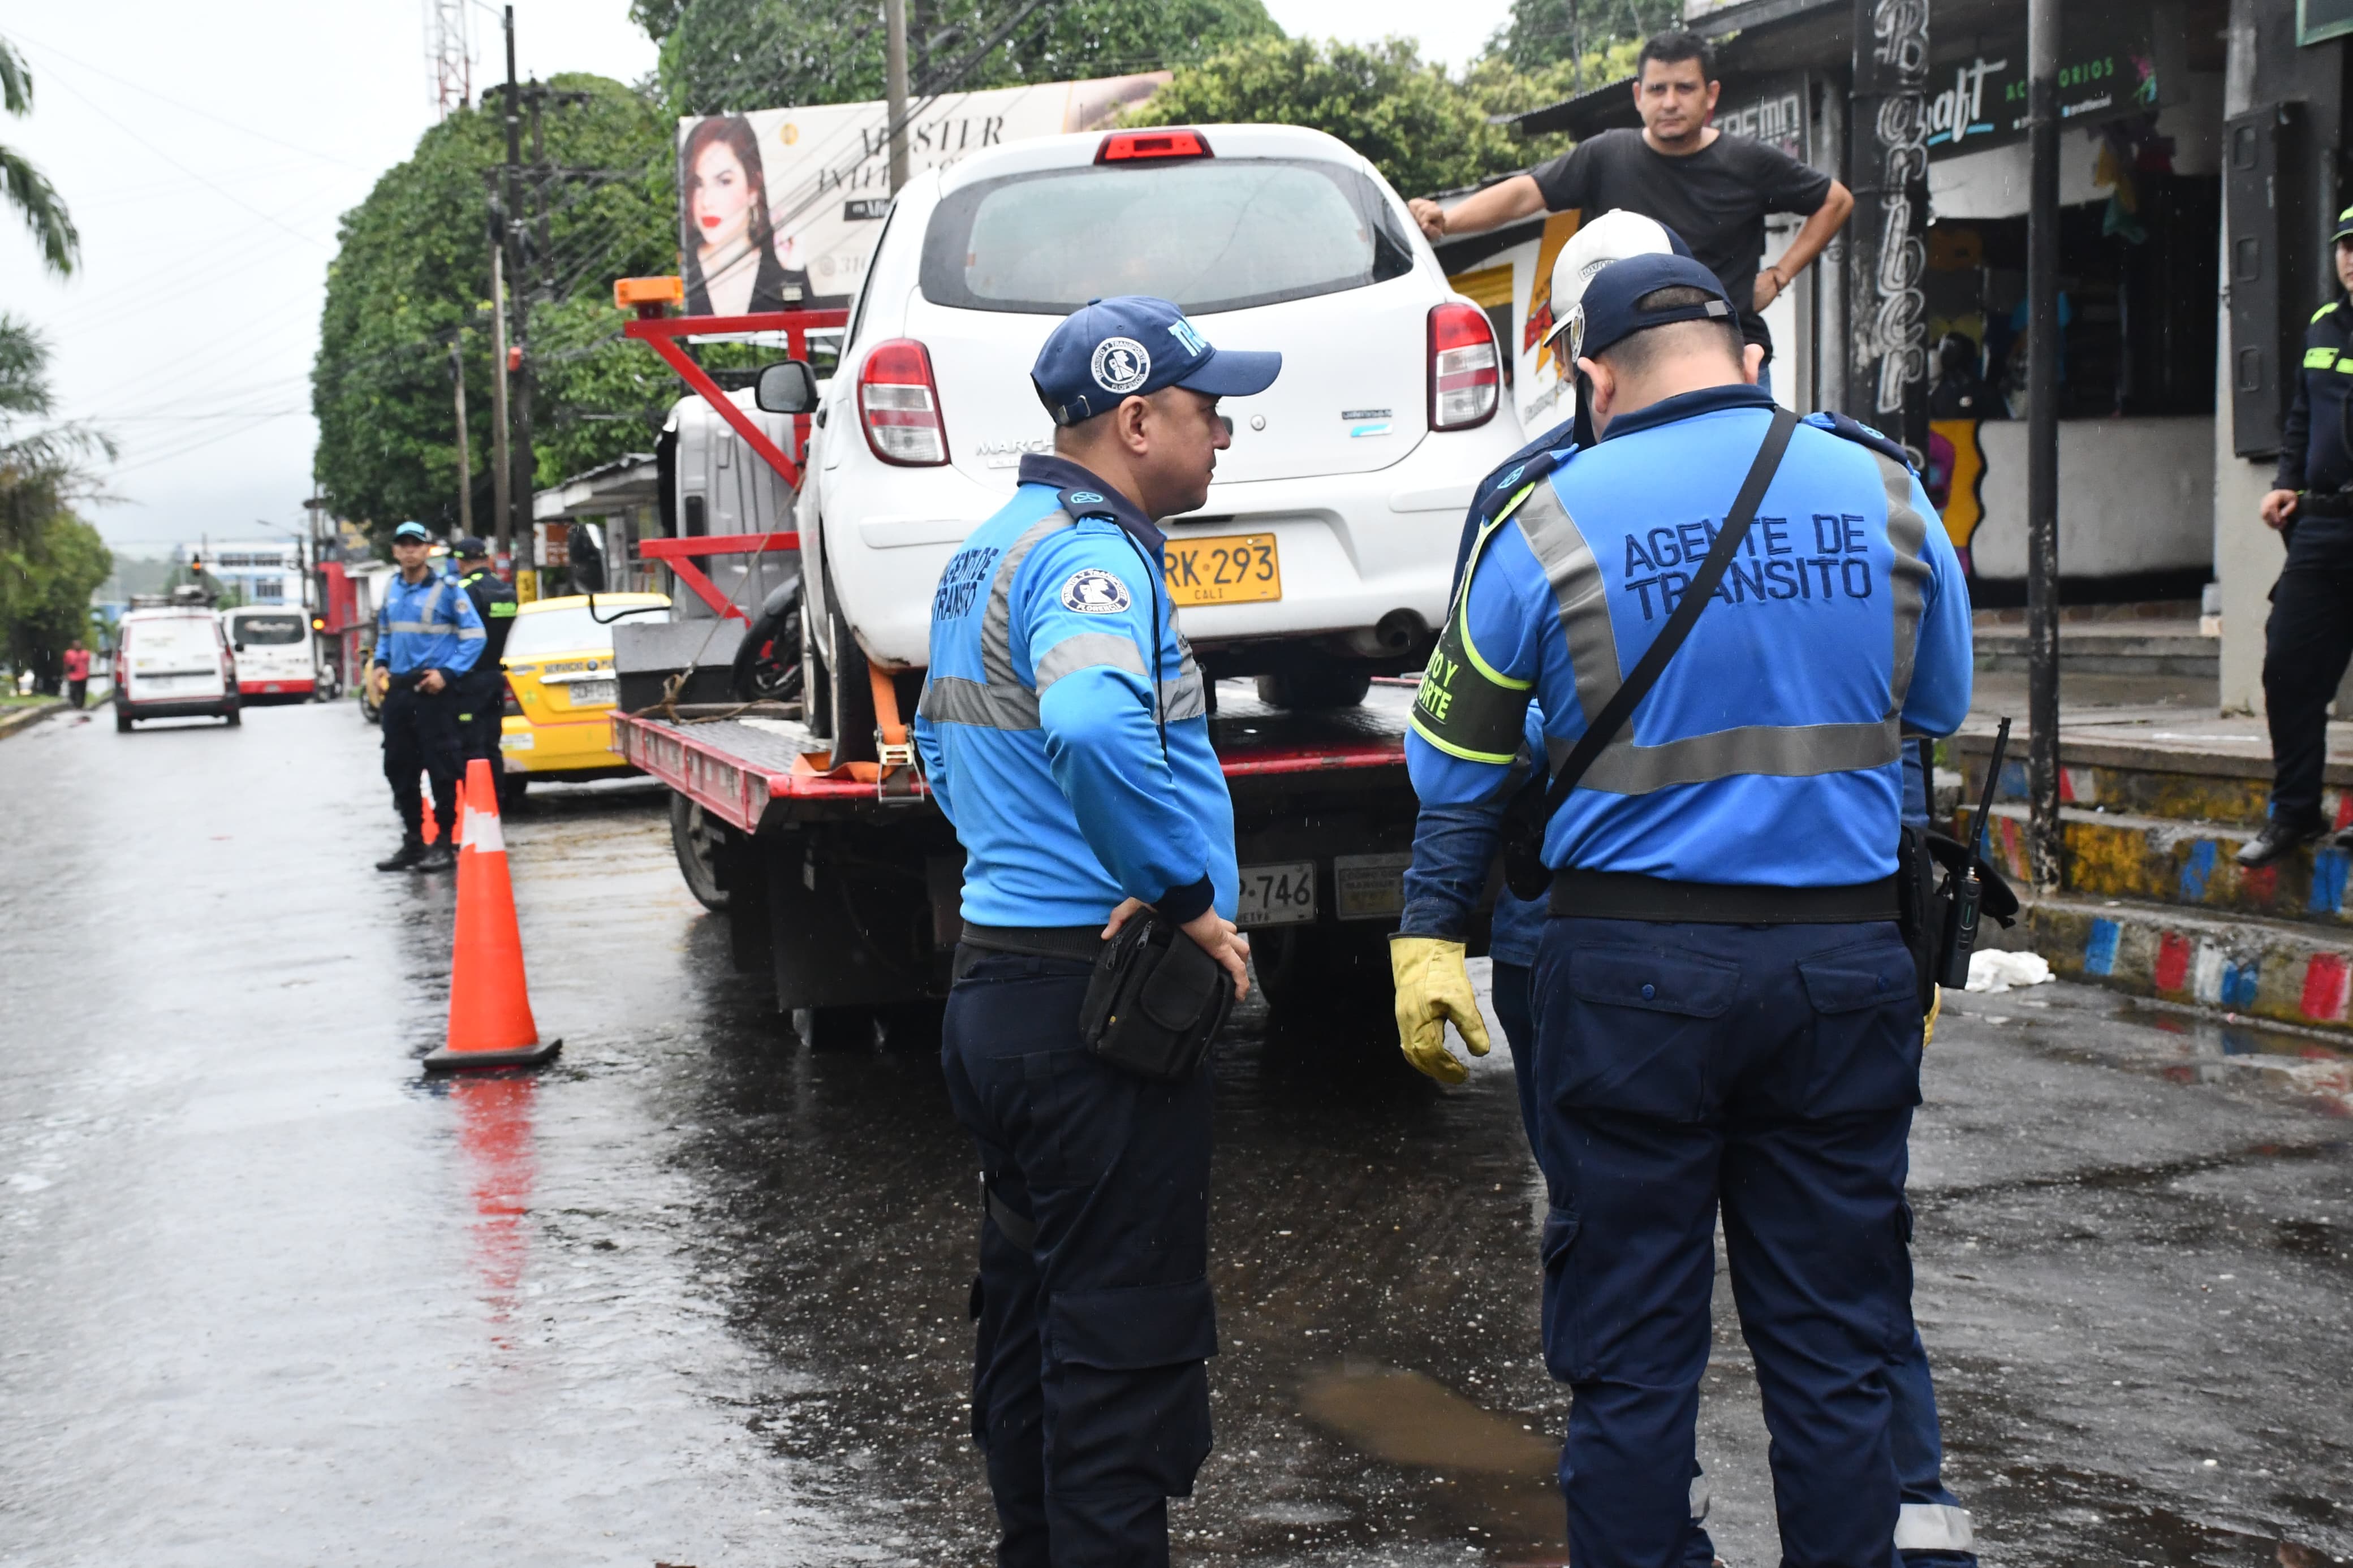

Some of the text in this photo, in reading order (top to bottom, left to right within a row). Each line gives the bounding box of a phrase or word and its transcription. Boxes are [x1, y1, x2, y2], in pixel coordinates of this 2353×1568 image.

[1812, 513, 1868, 554] DE
[1195, 588, 1223, 600] CALI
[1076, 603, 1124, 612] FLORENCIA
[1443, 660, 1459, 688] Y
